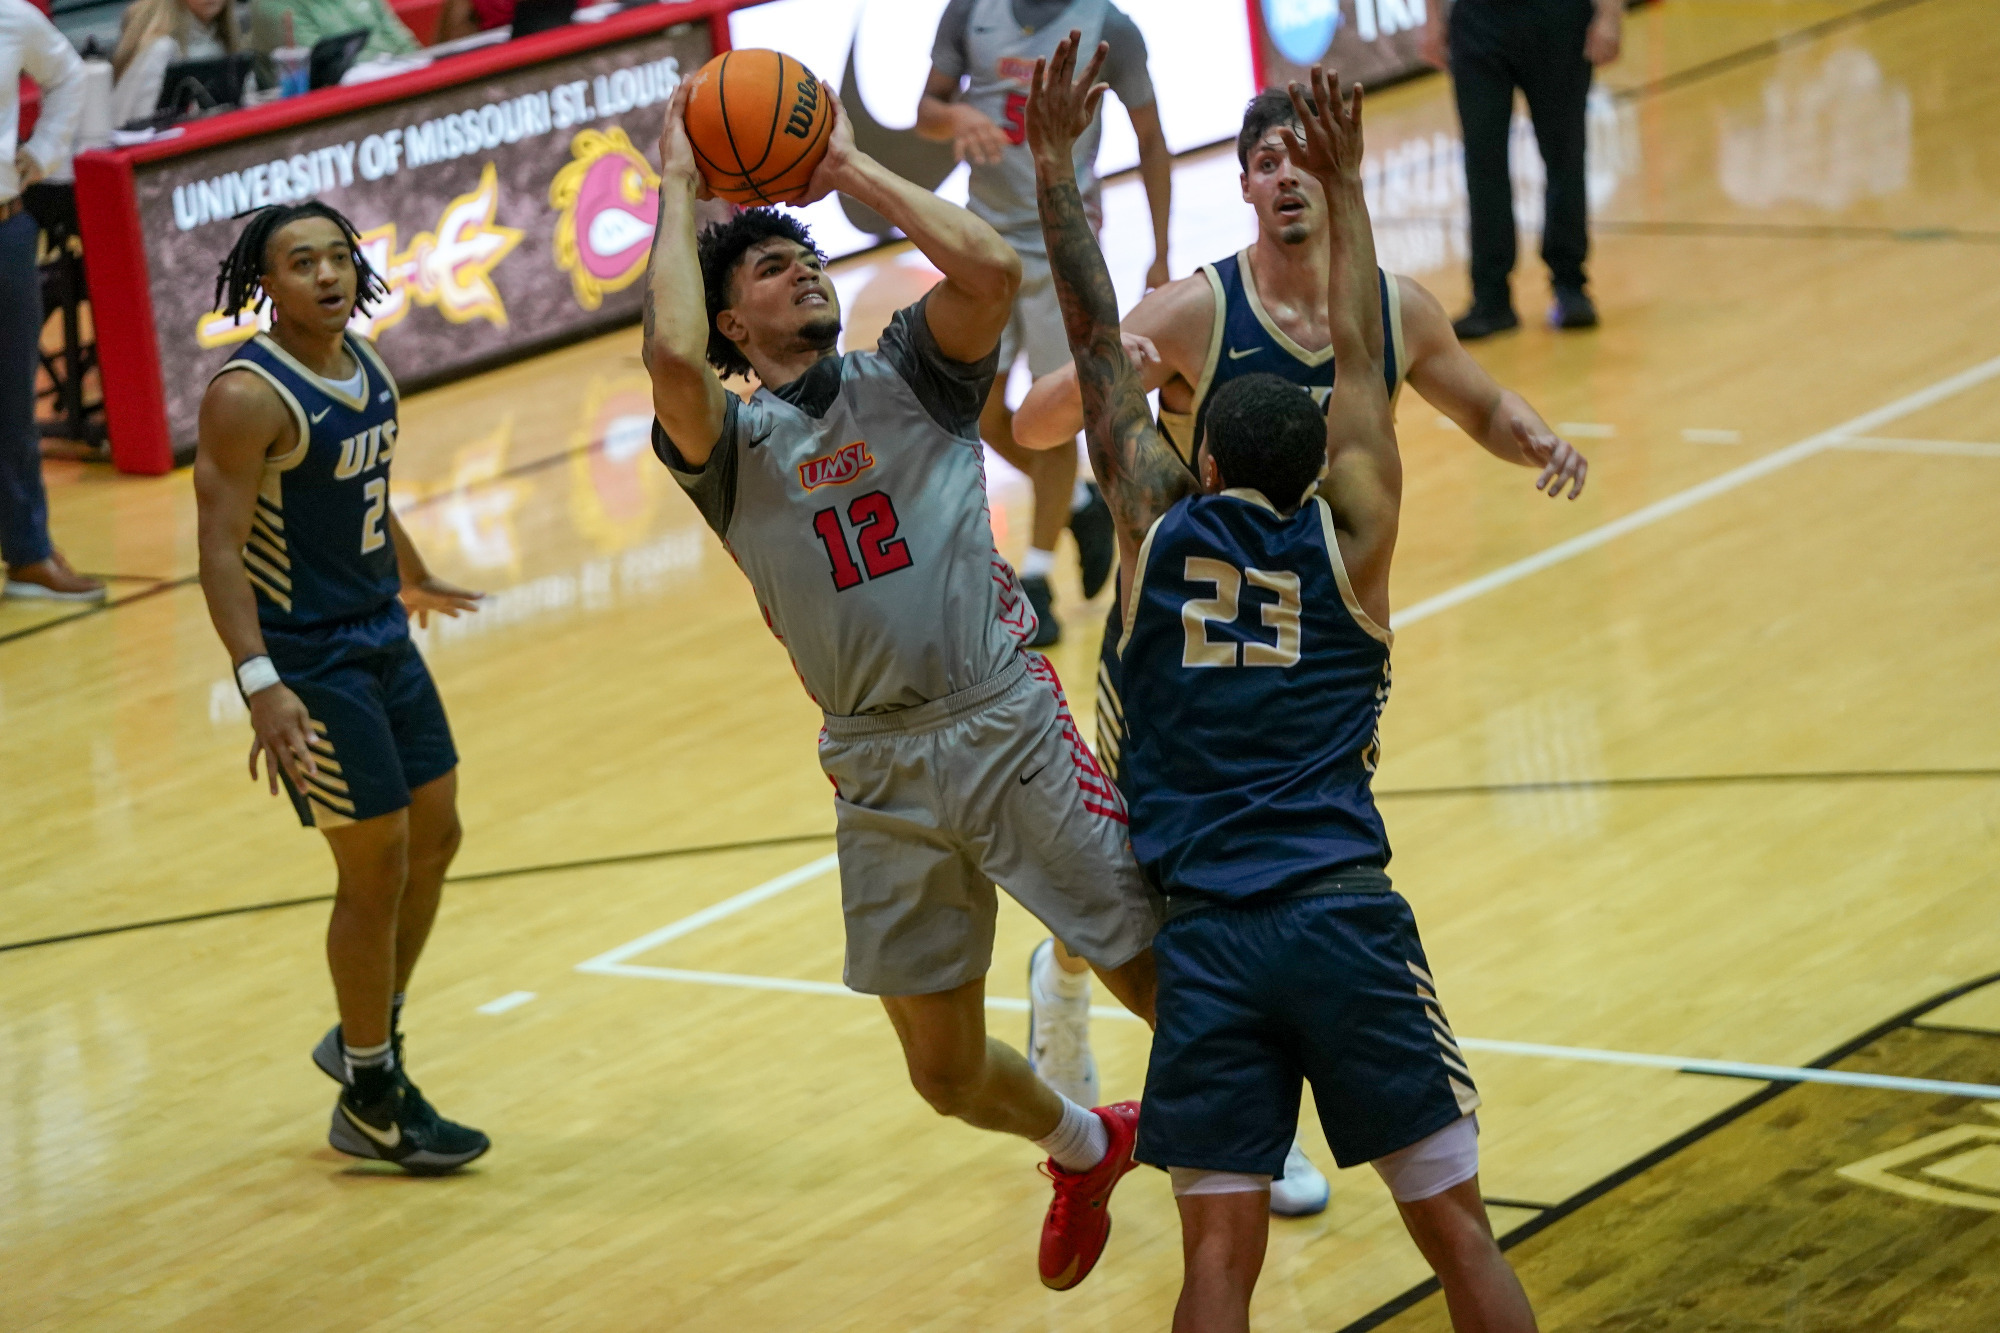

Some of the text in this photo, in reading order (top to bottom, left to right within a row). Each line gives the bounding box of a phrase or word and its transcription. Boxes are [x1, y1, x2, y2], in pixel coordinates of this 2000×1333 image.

[172, 56, 682, 231] UNIVERSITY OF MISSOURI ST. LOUIS
[334, 418, 399, 480] UIS
[801, 442, 874, 490] UMSL
[360, 476, 386, 556] 2
[812, 489, 914, 593] 12
[1181, 555, 1303, 669] 23
